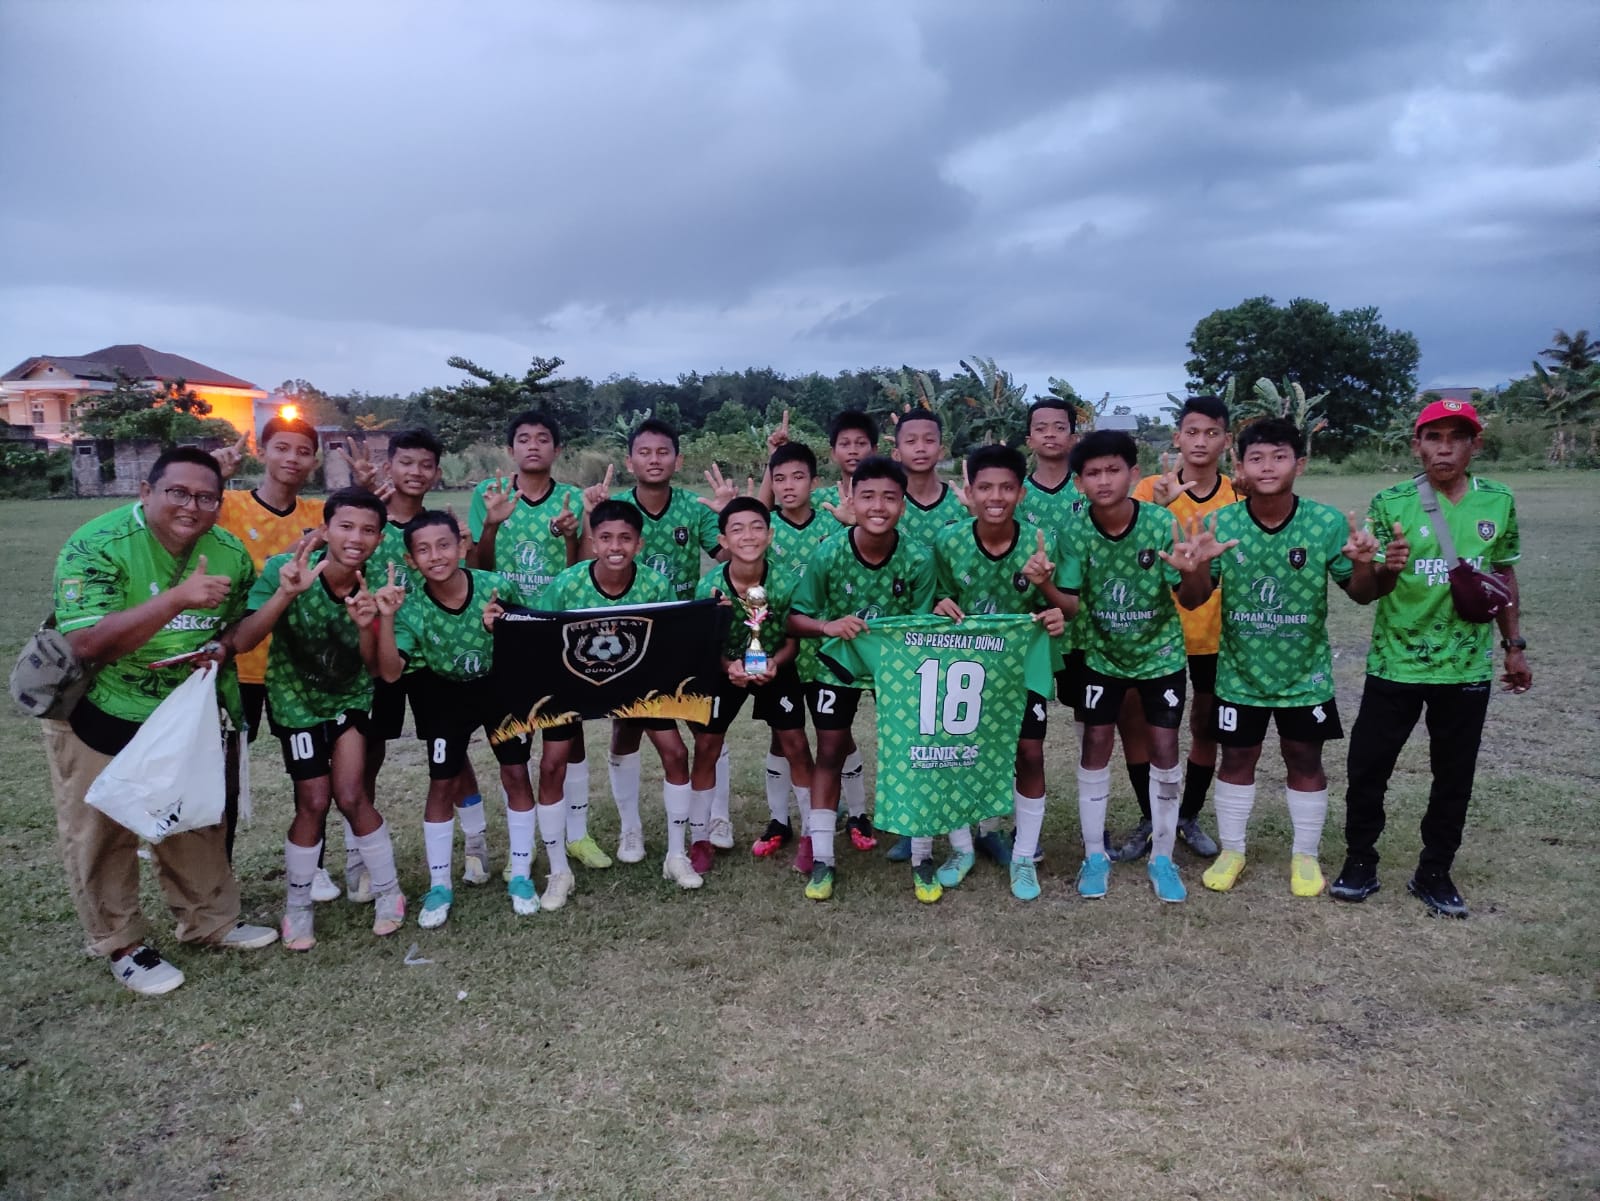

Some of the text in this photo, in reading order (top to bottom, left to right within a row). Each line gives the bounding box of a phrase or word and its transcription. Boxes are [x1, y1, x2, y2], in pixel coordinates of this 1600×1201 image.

[1229, 610, 1308, 625] TAMAN KULINER
[904, 631, 1005, 652] SSB PERSEKAT DUMAI
[816, 688, 837, 715] 12
[915, 658, 986, 736] 18
[1085, 684, 1104, 709] 17
[1218, 705, 1238, 732] 19
[289, 731, 314, 761] 10
[432, 737, 447, 764] 8
[910, 744, 979, 761] KLINIK 26
